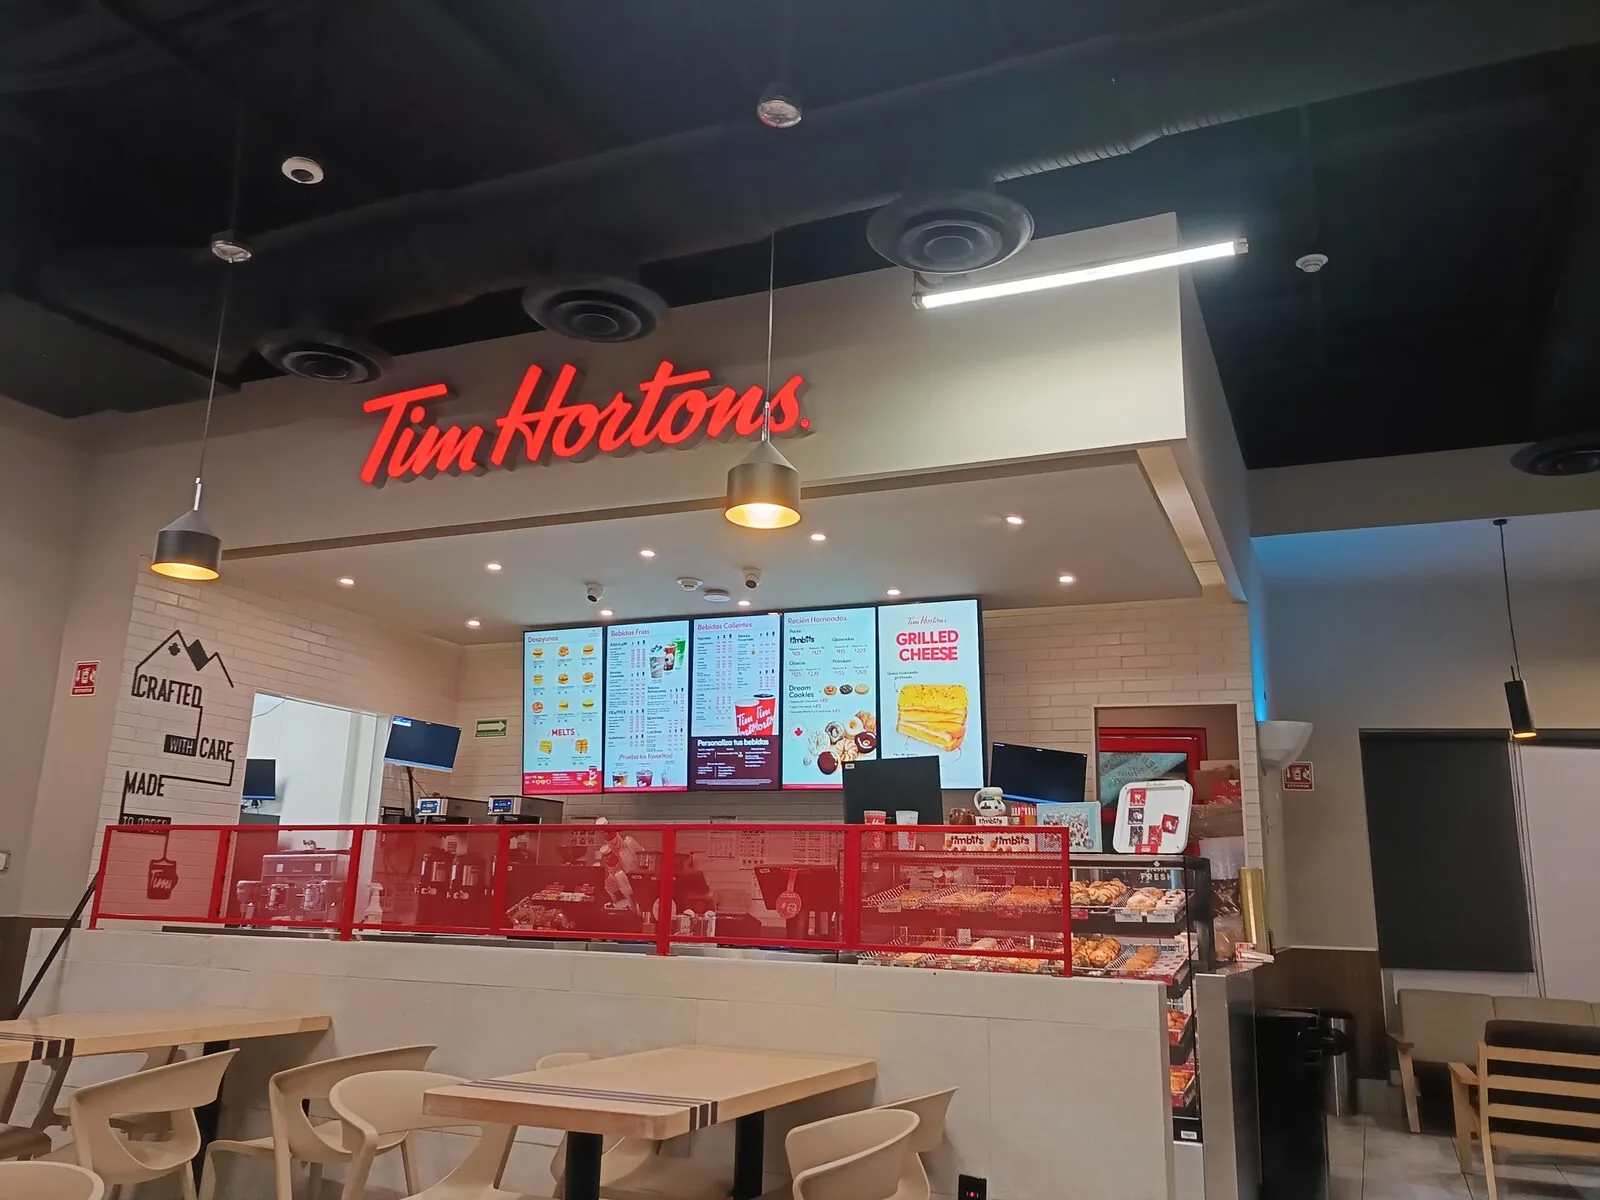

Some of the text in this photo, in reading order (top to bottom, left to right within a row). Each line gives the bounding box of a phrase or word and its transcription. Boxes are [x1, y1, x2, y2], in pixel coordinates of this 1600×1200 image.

[360, 360, 805, 484] Tim Hortons
[698, 623, 722, 631] Bebidas
[528, 636, 558, 644] Desayunos
[896, 630, 959, 645] GRILLED
[899, 646, 958, 661] CHEESE
[134, 674, 203, 708] CRAFTED
[788, 691, 814, 699] Cookies
[737, 713, 753, 726] Tim
[551, 728, 575, 737] MELTS
[170, 738, 194, 754] WITH
[697, 739, 733, 747] Personaliza
[744, 738, 769, 746] bebidas
[199, 737, 235, 761] CARE
[124, 770, 165, 797] MADE
[951, 834, 984, 846] timbits
[994, 835, 1030, 846] timbits
[1140, 872, 1173, 881] FRESH
